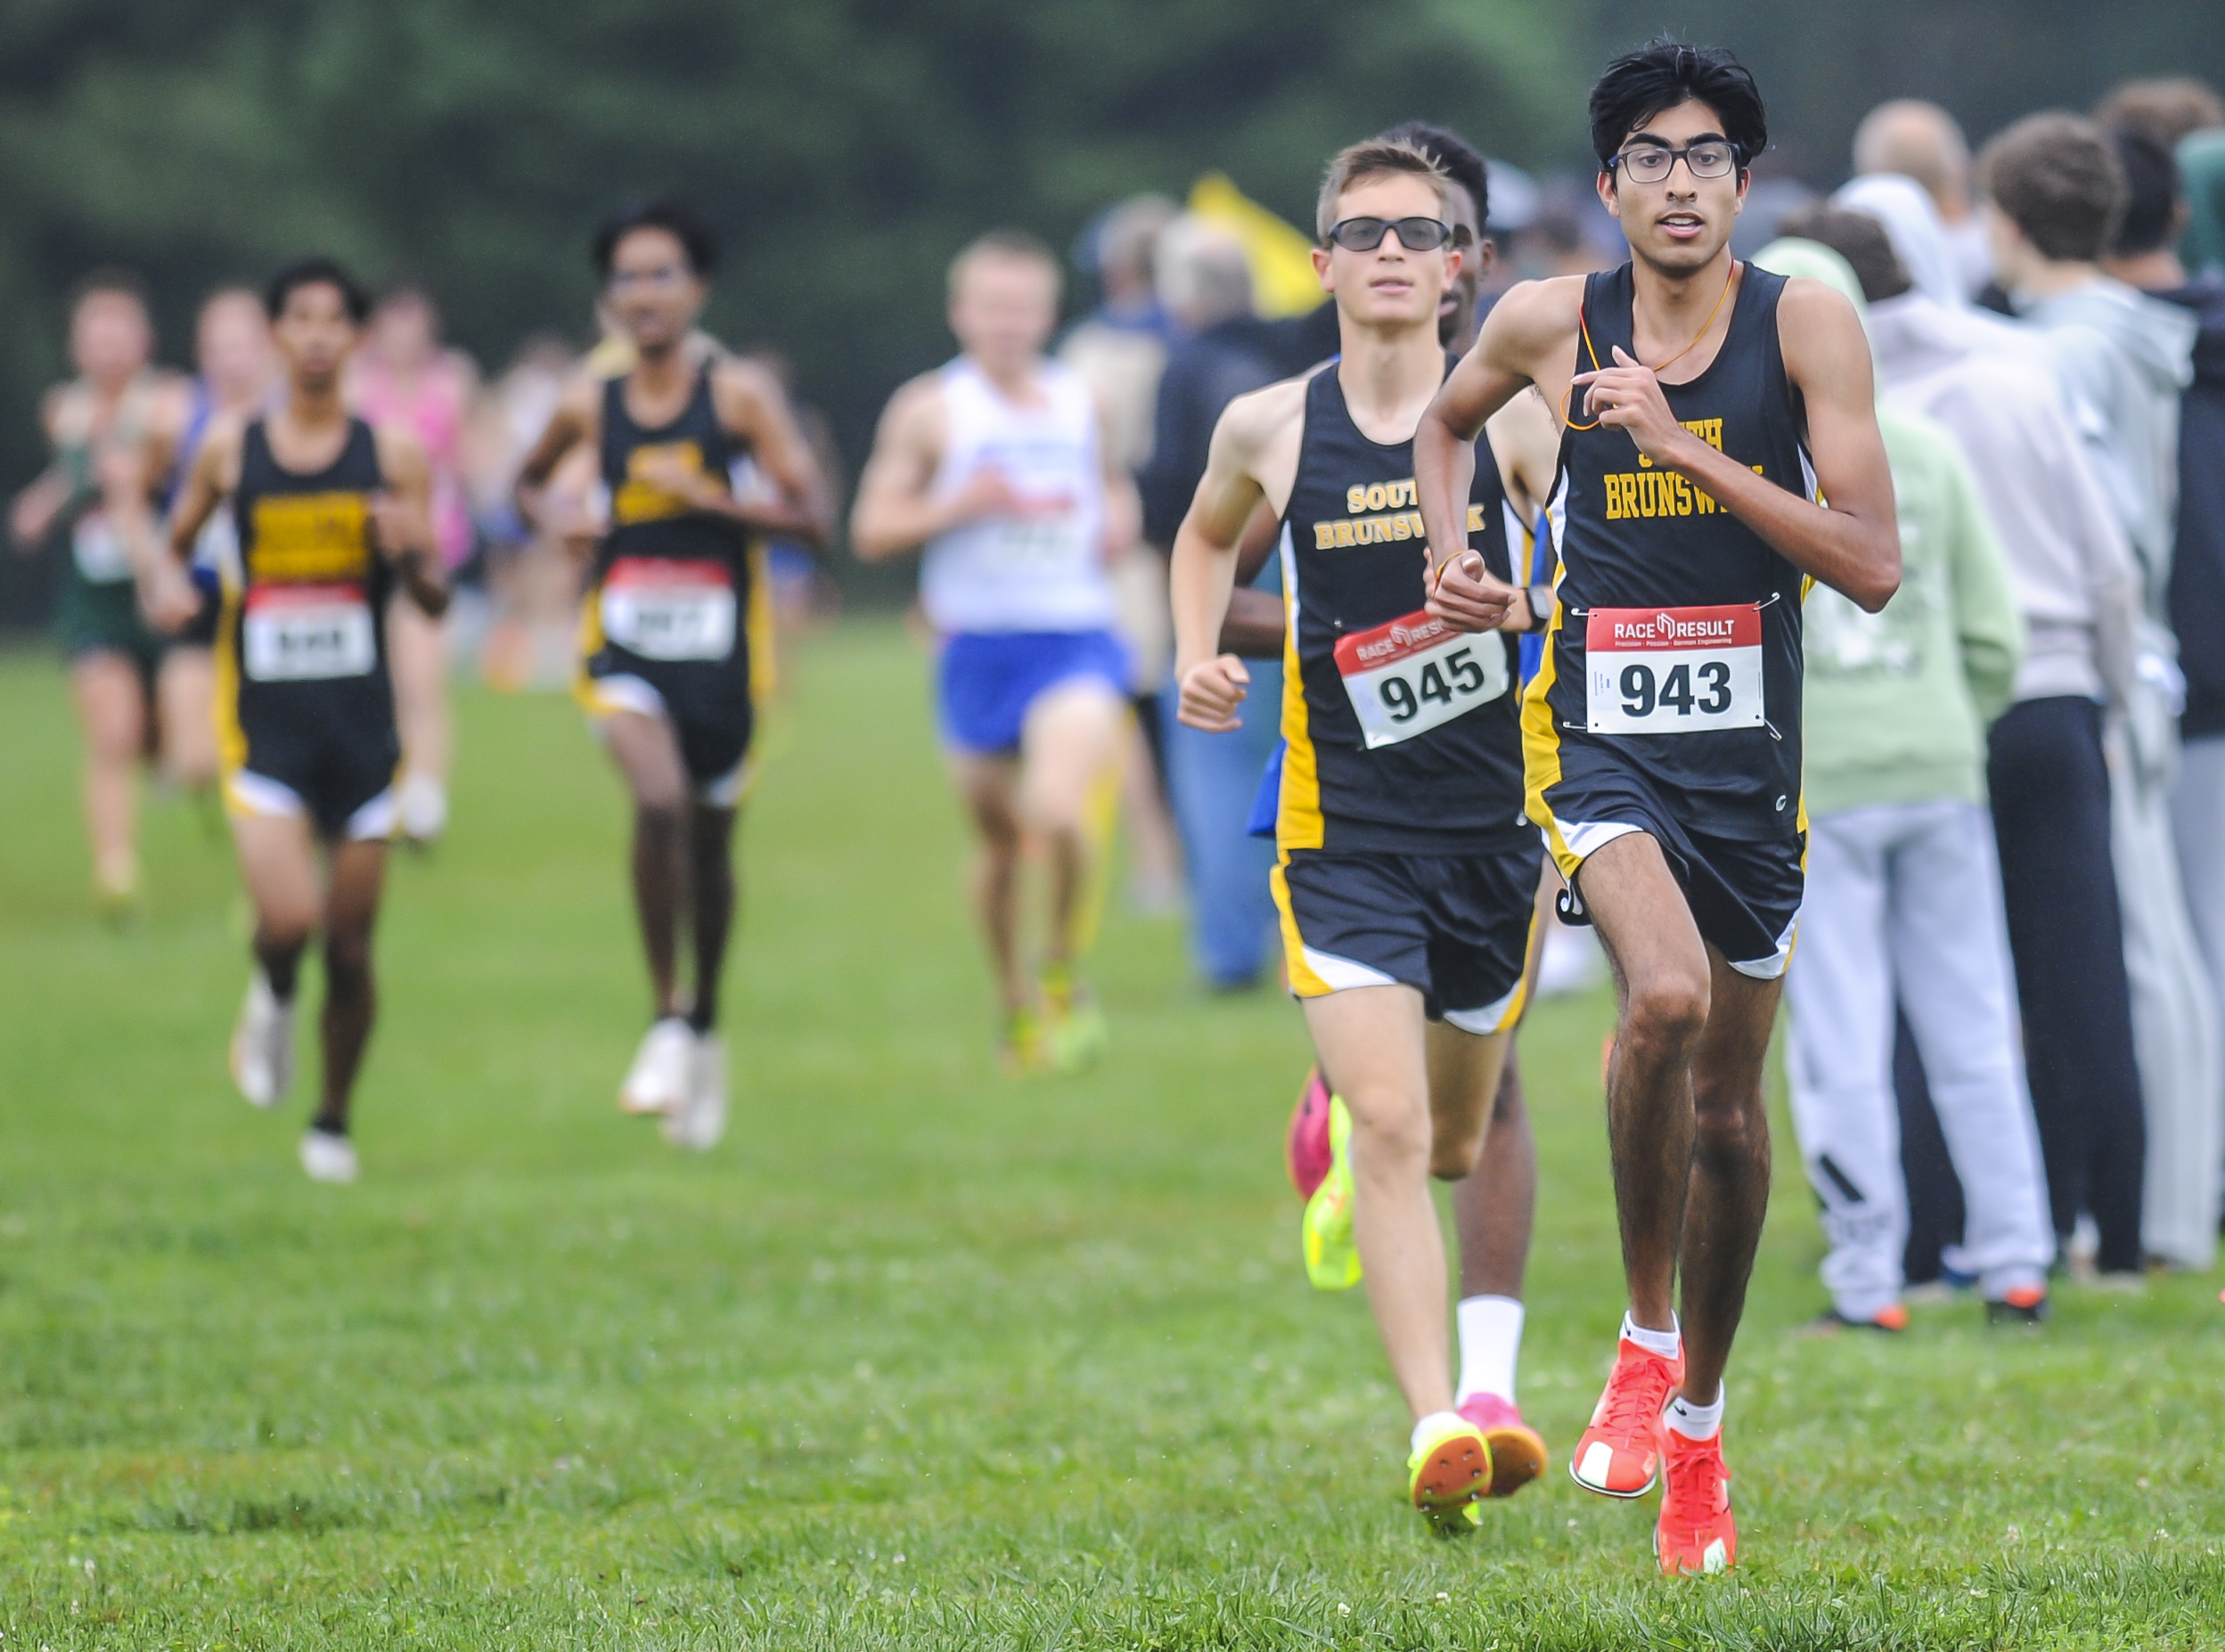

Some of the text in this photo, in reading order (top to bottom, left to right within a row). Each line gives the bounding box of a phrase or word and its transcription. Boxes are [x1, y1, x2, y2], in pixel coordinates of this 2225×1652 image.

[1347, 478, 1419, 513] SOUT
[1604, 465, 1763, 519] BRUNSW
[1313, 503, 1485, 550] BRUNSK
[1356, 637, 1395, 661] RACE
[1411, 617, 1444, 642] RES
[1615, 619, 1735, 639] RACE RESULT
[1379, 647, 1485, 722] 945
[1619, 661, 1732, 718] 943
